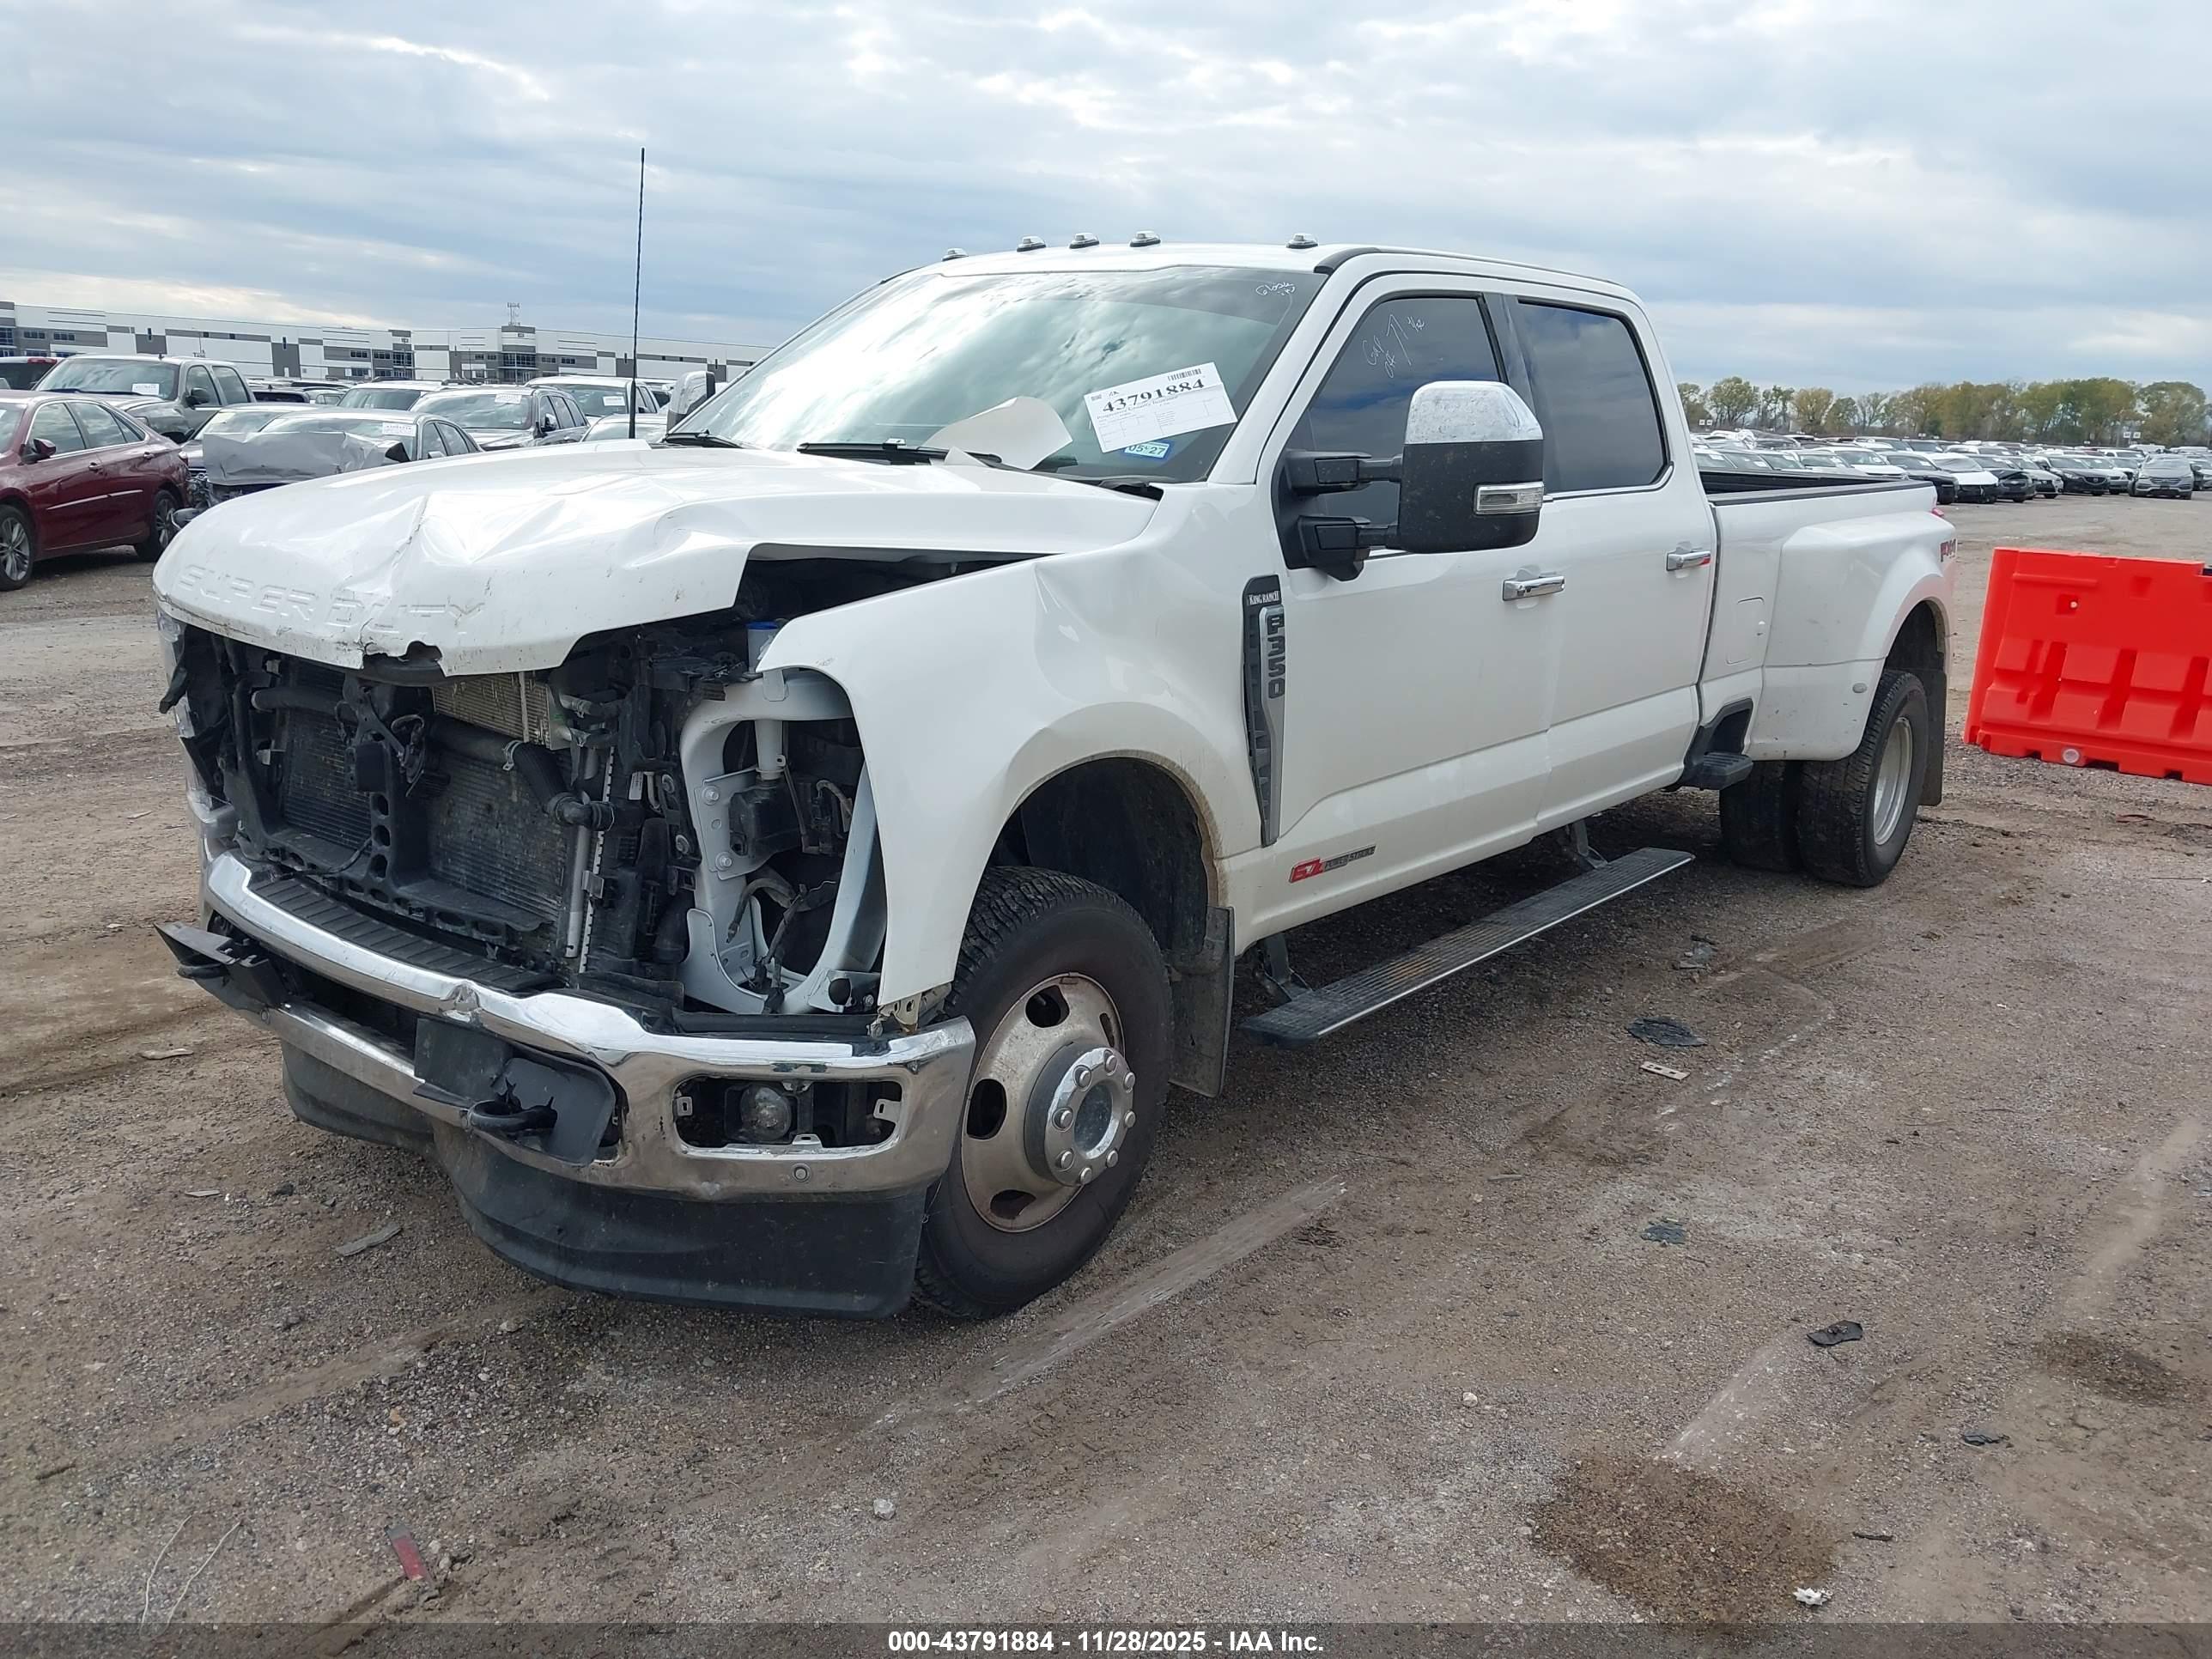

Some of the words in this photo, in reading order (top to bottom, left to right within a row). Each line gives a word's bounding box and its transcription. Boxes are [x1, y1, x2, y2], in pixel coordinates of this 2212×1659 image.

[1103, 378, 1205, 412] 43791884
[1148, 447, 1166, 455] 27
[1267, 613, 1285, 699] F350
